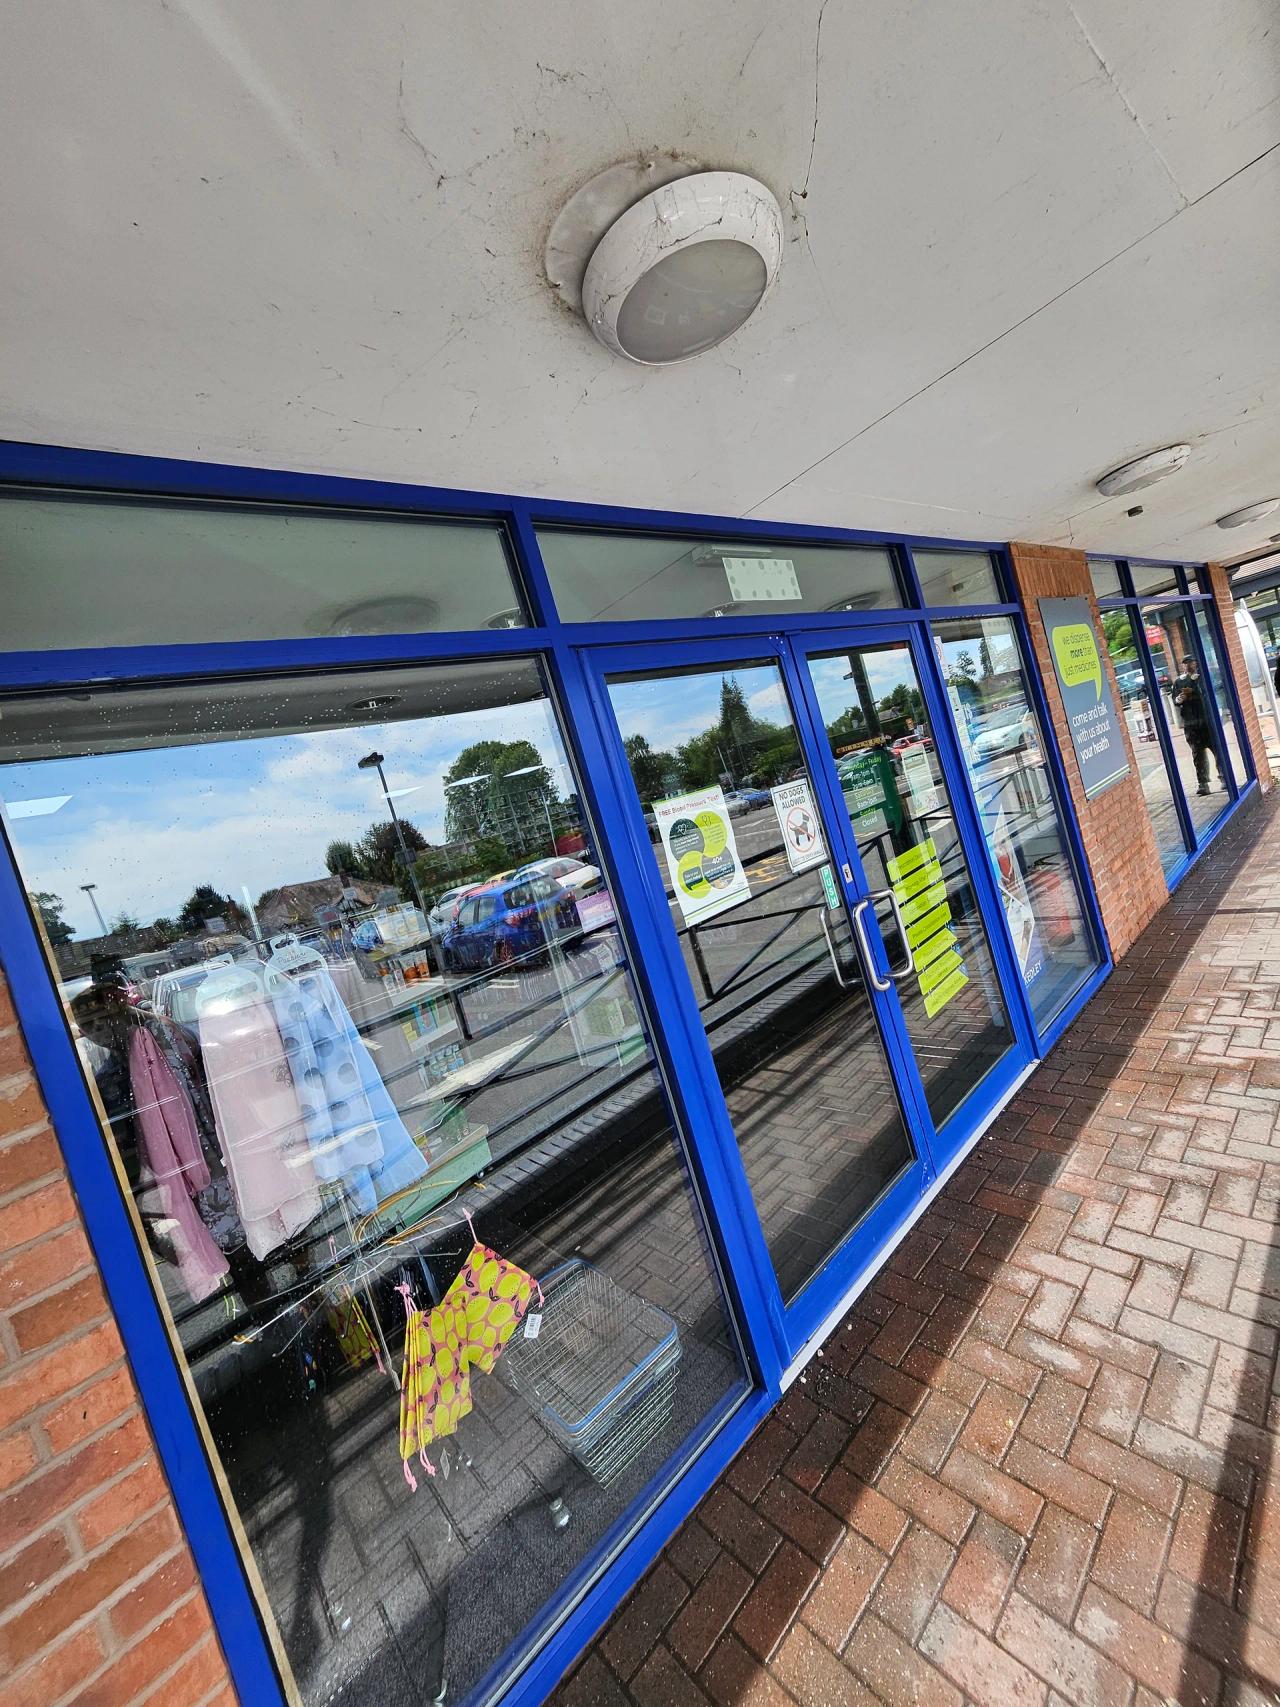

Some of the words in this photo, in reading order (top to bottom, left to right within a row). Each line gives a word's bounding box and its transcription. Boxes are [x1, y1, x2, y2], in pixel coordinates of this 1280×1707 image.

[1070, 632, 1090, 645] dispense
[1070, 648, 1083, 658] more
[1064, 663, 1074, 679] just
[1074, 660, 1097, 674] medicines
[1072, 712, 1088, 727] come
[1088, 704, 1099, 721] and
[1098, 702, 1108, 717] talk
[1076, 727, 1089, 744] with
[1089, 727, 1096, 739] us
[1096, 718, 1111, 735] about
[1080, 745, 1093, 764] your
[1092, 735, 1110, 755] health
[779, 791, 788, 800] NO
[789, 786, 804, 797] DOGS
[782, 796, 806, 809] ALLOWED
[659, 808, 671, 816] FREE
[862, 816, 878, 827] Closed
[712, 856, 723, 865] 40+
